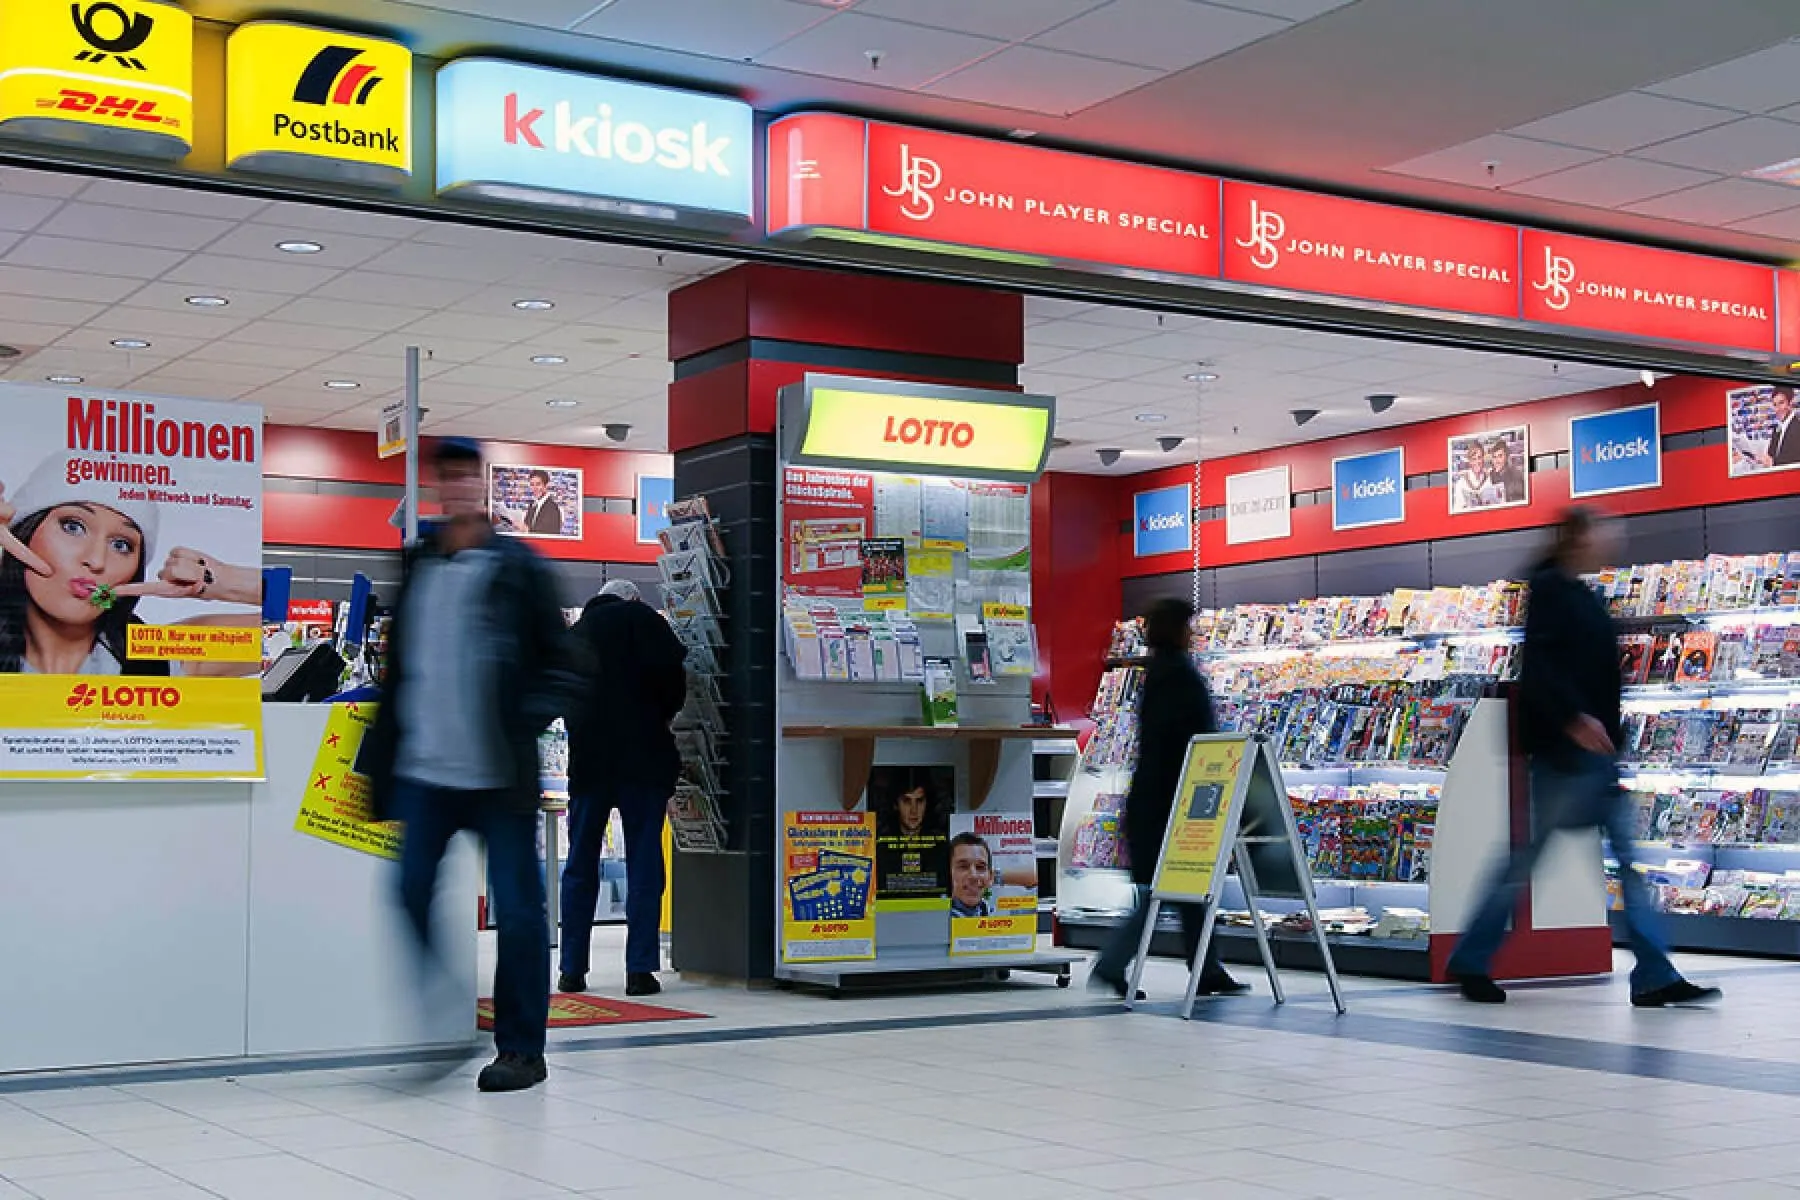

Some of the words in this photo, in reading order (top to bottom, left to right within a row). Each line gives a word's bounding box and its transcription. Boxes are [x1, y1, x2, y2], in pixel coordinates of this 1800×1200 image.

[57, 88, 162, 123] DHL
[273, 113, 400, 153] Postbank
[504, 92, 545, 148] k
[555, 101, 732, 176] kiosk
[944, 188, 1014, 211] JOHN
[1024, 199, 1110, 225] PLAYER
[1118, 213, 1210, 239] SPECIAL
[1286, 239, 1345, 259] JOHN
[1353, 248, 1427, 271] PLAYER
[1431, 259, 1511, 283] SPECIAL
[1576, 281, 1626, 299] JOHN
[1633, 290, 1696, 311] PLAYER
[1701, 299, 1768, 320] SPECIAL
[67, 397, 255, 463] Millionen
[883, 415, 975, 449] LOTTO
[1595, 436, 1649, 463] kiosk
[66, 455, 176, 486] gewinnen.
[192, 492, 210, 505] und
[1353, 477, 1396, 499] kiosk
[1150, 512, 1184, 531] kiosk
[101, 686, 181, 707] LOTTO
[974, 815, 1032, 836] Millionen
